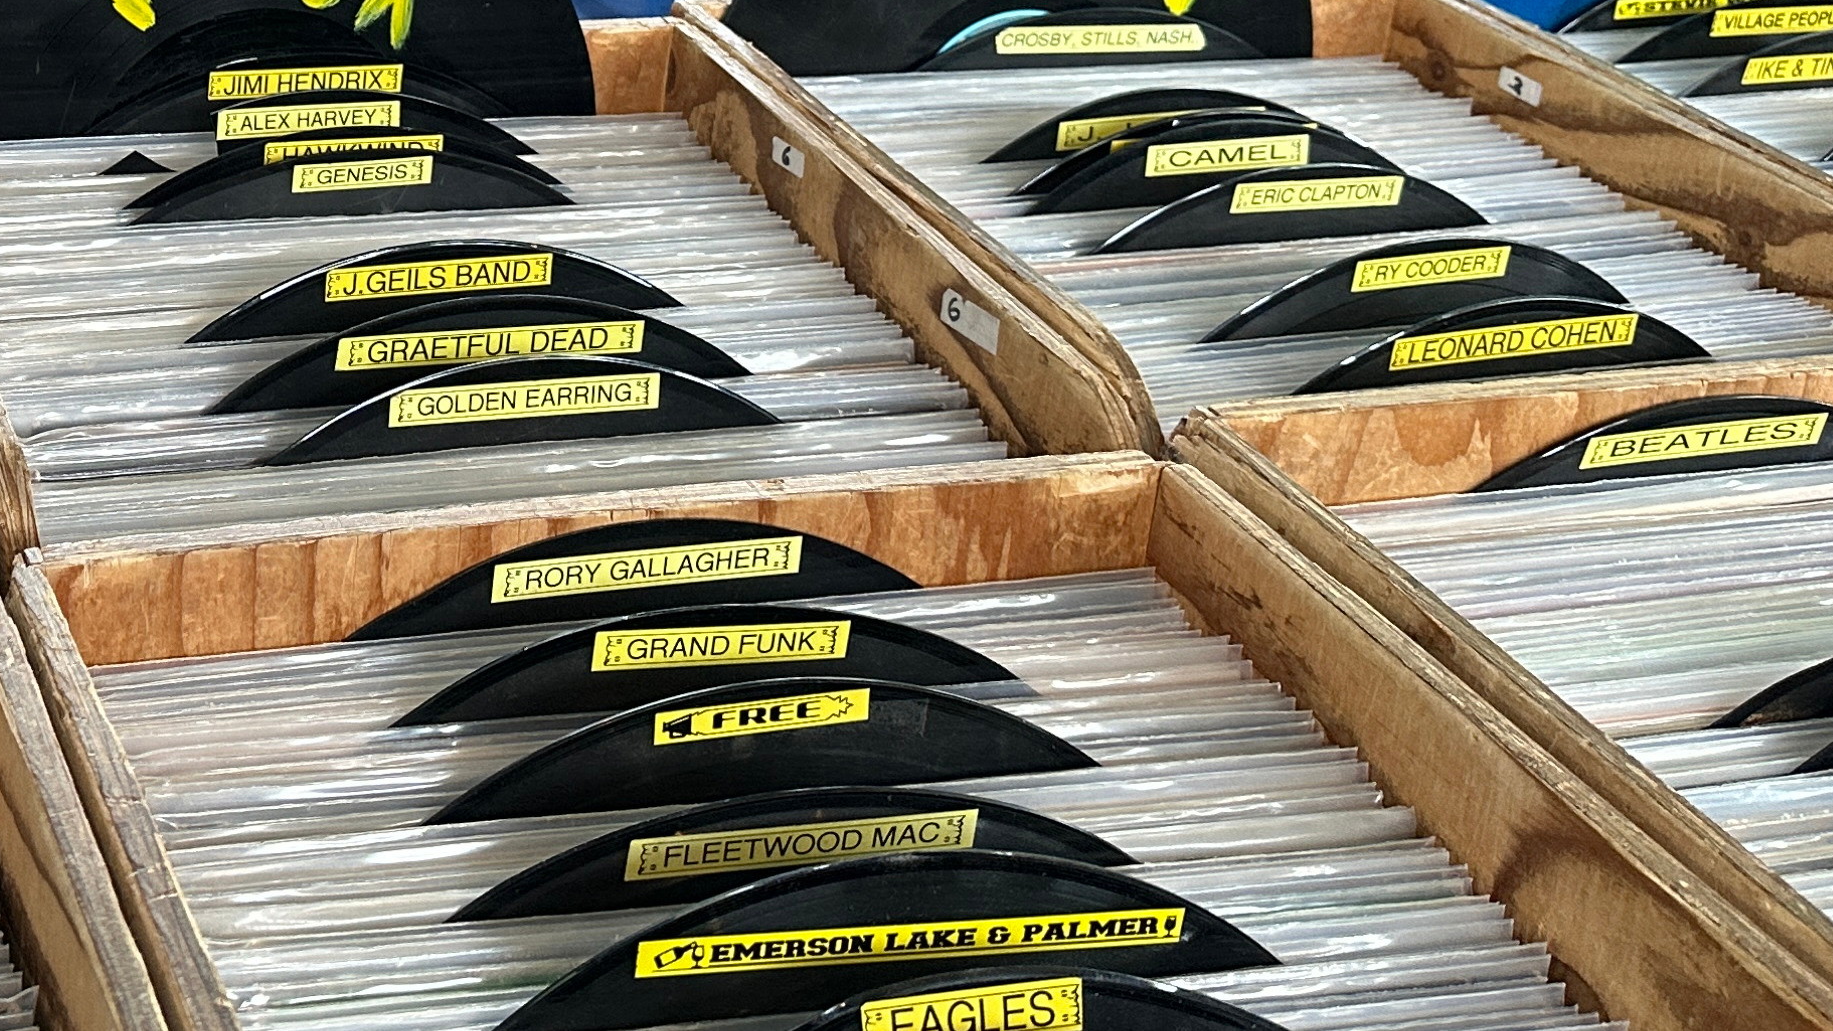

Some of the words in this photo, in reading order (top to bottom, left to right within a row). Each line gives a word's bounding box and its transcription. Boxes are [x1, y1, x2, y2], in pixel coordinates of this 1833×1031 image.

[1724, 13, 1784, 30] VILLAGE
[223, 75, 269, 96] JIMI
[278, 69, 383, 93] HENDRIX
[1756, 60, 1788, 79] IKE
[1791, 59, 1803, 77] &
[240, 112, 290, 131] ALEX
[297, 108, 377, 128] HARVEY
[781, 146, 792, 167] 6
[1169, 144, 1287, 167] CAMEL
[317, 163, 408, 185] GENESIS
[1251, 187, 1294, 205] ERIC
[1299, 183, 1382, 203] CLAPTON
[342, 264, 447, 298] J.GEILS
[456, 260, 531, 286] BAND
[1374, 262, 1403, 282] RY
[1405, 255, 1487, 279] COODER
[947, 296, 961, 322] 6
[368, 332, 520, 363] GRAETFUL
[529, 326, 609, 353] DEAD
[1407, 328, 1524, 364] LEONARD
[1529, 320, 1617, 349] COHEN
[416, 385, 518, 418] GOLDEN
[524, 380, 633, 410] EARRING
[1611, 424, 1796, 456] BEATLES
[524, 560, 602, 593] RORY
[607, 546, 770, 584] GALLAGHER
[627, 632, 731, 662] GRAND
[737, 629, 818, 656] FUNK
[711, 698, 823, 730] FREE
[664, 829, 862, 866] FLEETWOOD
[873, 821, 940, 847] MAC
[709, 935, 873, 962] EMERSON
[885, 928, 977, 951] LAKE
[986, 925, 1012, 946] &
[1021, 915, 1160, 941] PALMER
[890, 989, 1056, 1031] EAGLES
